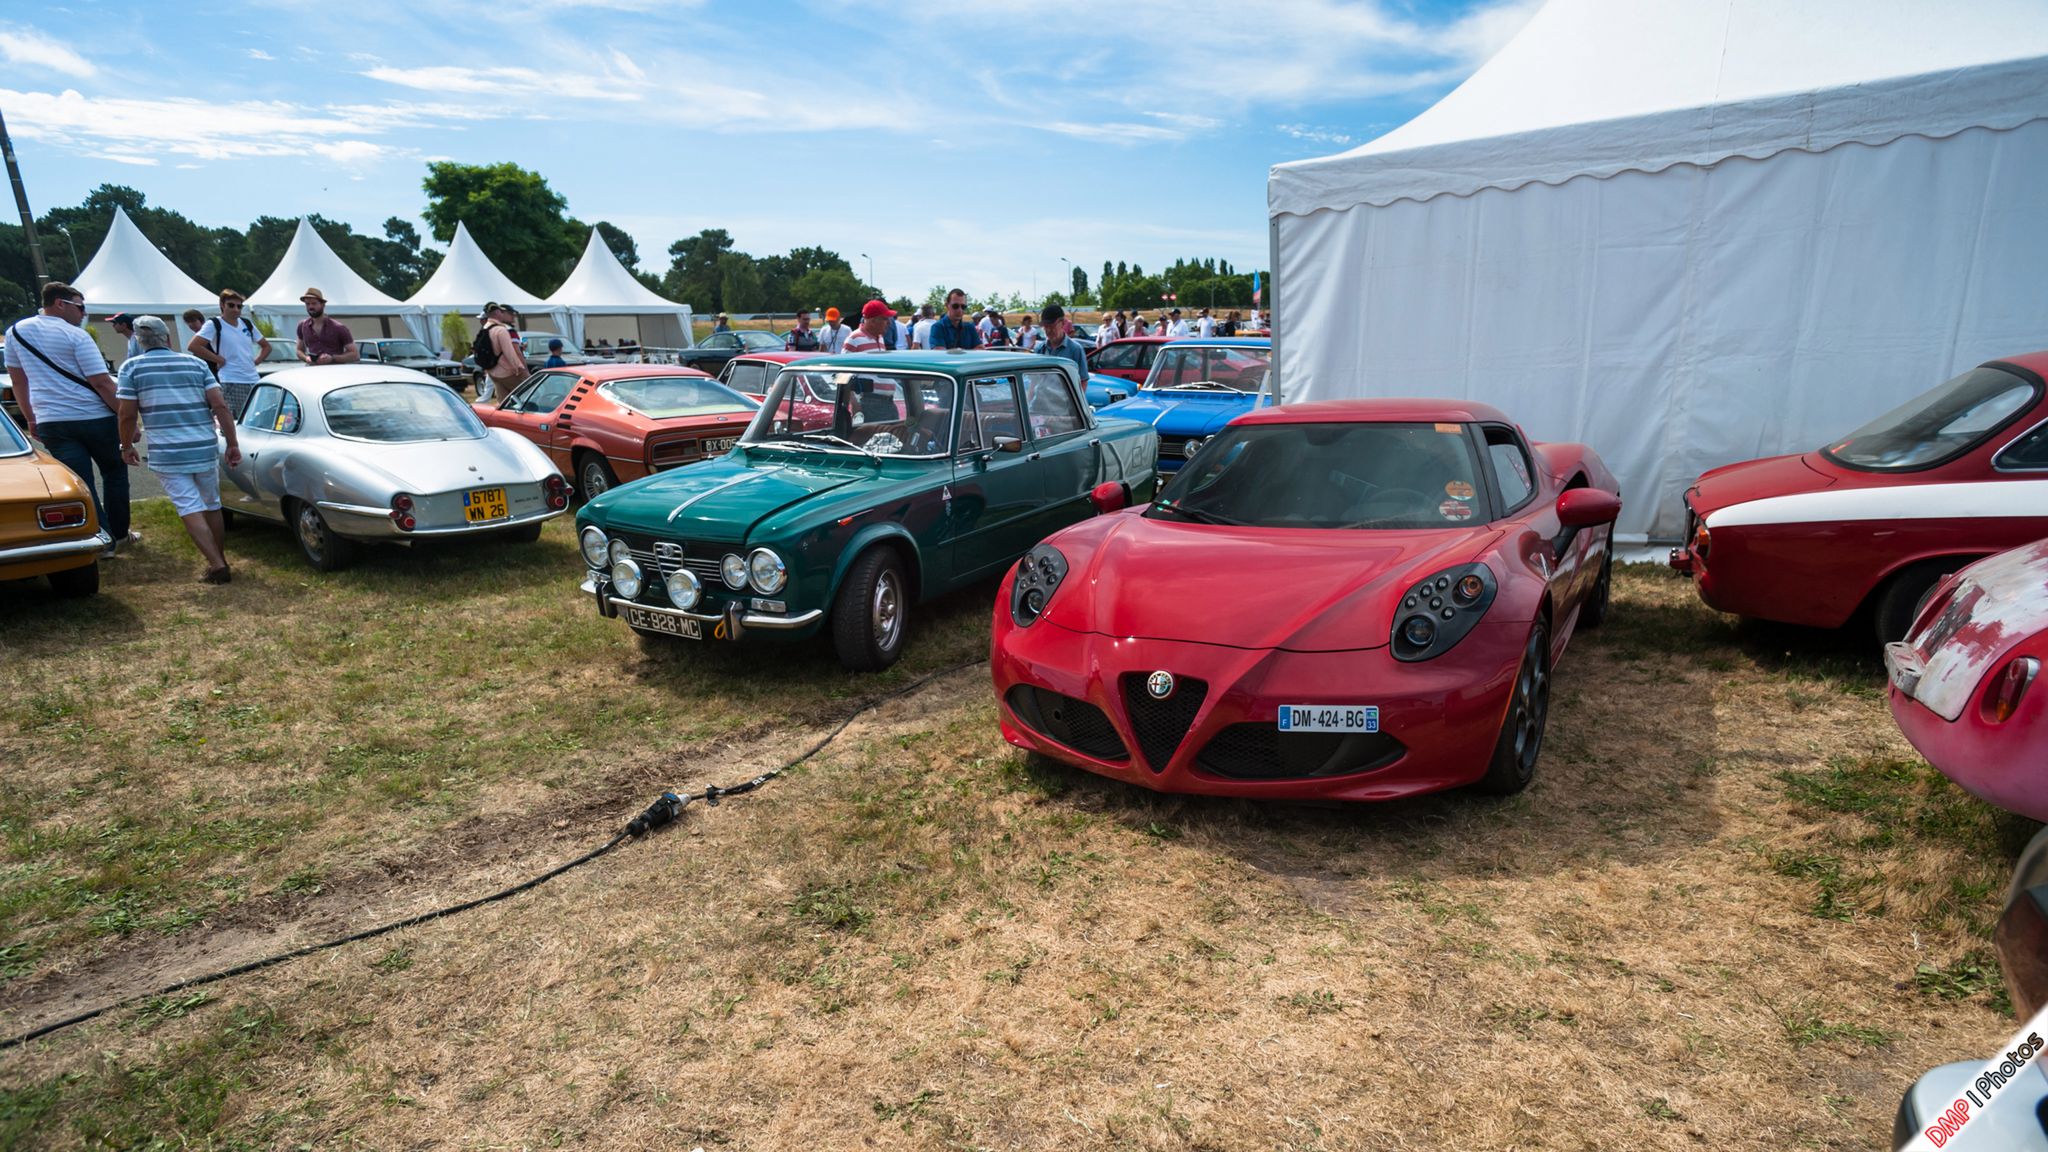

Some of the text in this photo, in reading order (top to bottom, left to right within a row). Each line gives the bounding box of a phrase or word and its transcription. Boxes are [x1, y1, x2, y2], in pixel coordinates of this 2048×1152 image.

[472, 488, 501, 505] 6787
[469, 504, 505, 521] WN 26
[1292, 709, 1364, 728] DM-424-BG
[1367, 721, 1376, 729] 33
